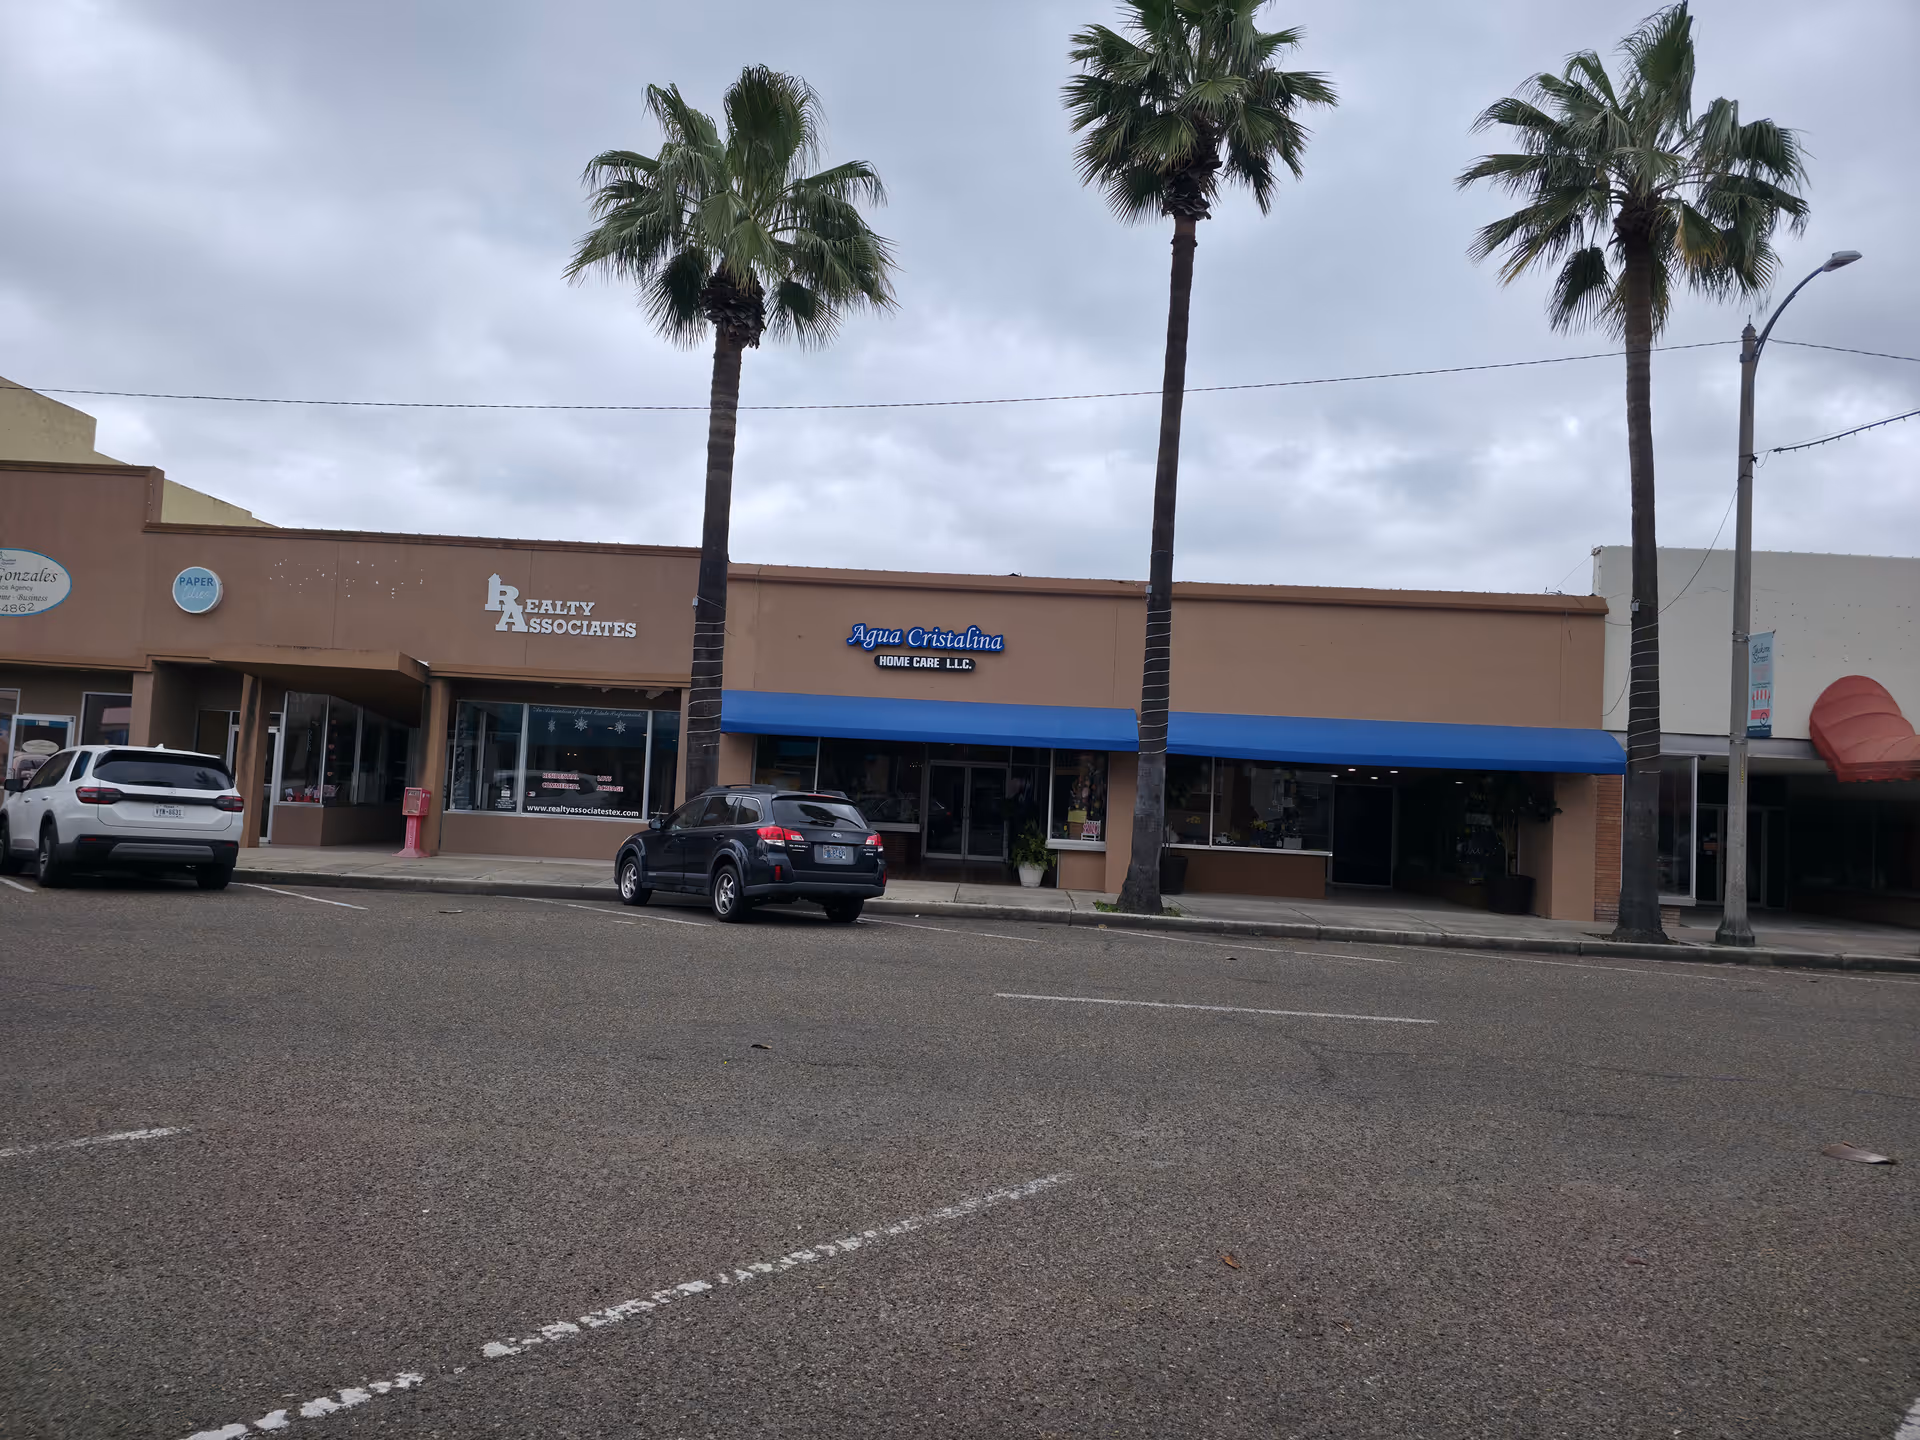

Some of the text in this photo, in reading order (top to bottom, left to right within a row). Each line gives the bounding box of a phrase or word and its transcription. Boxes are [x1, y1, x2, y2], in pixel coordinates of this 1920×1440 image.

[179, 577, 214, 587] PAPER
[17, 594, 48, 602] Business
[484, 573, 595, 616] REALTY
[495, 605, 637, 638] ASSOCIATES
[848, 624, 1003, 650] Agua Cristalina
[879, 655, 972, 669] HOME CARE L.L.C.
[527, 805, 639, 817] www.realtyassociatestex.com
